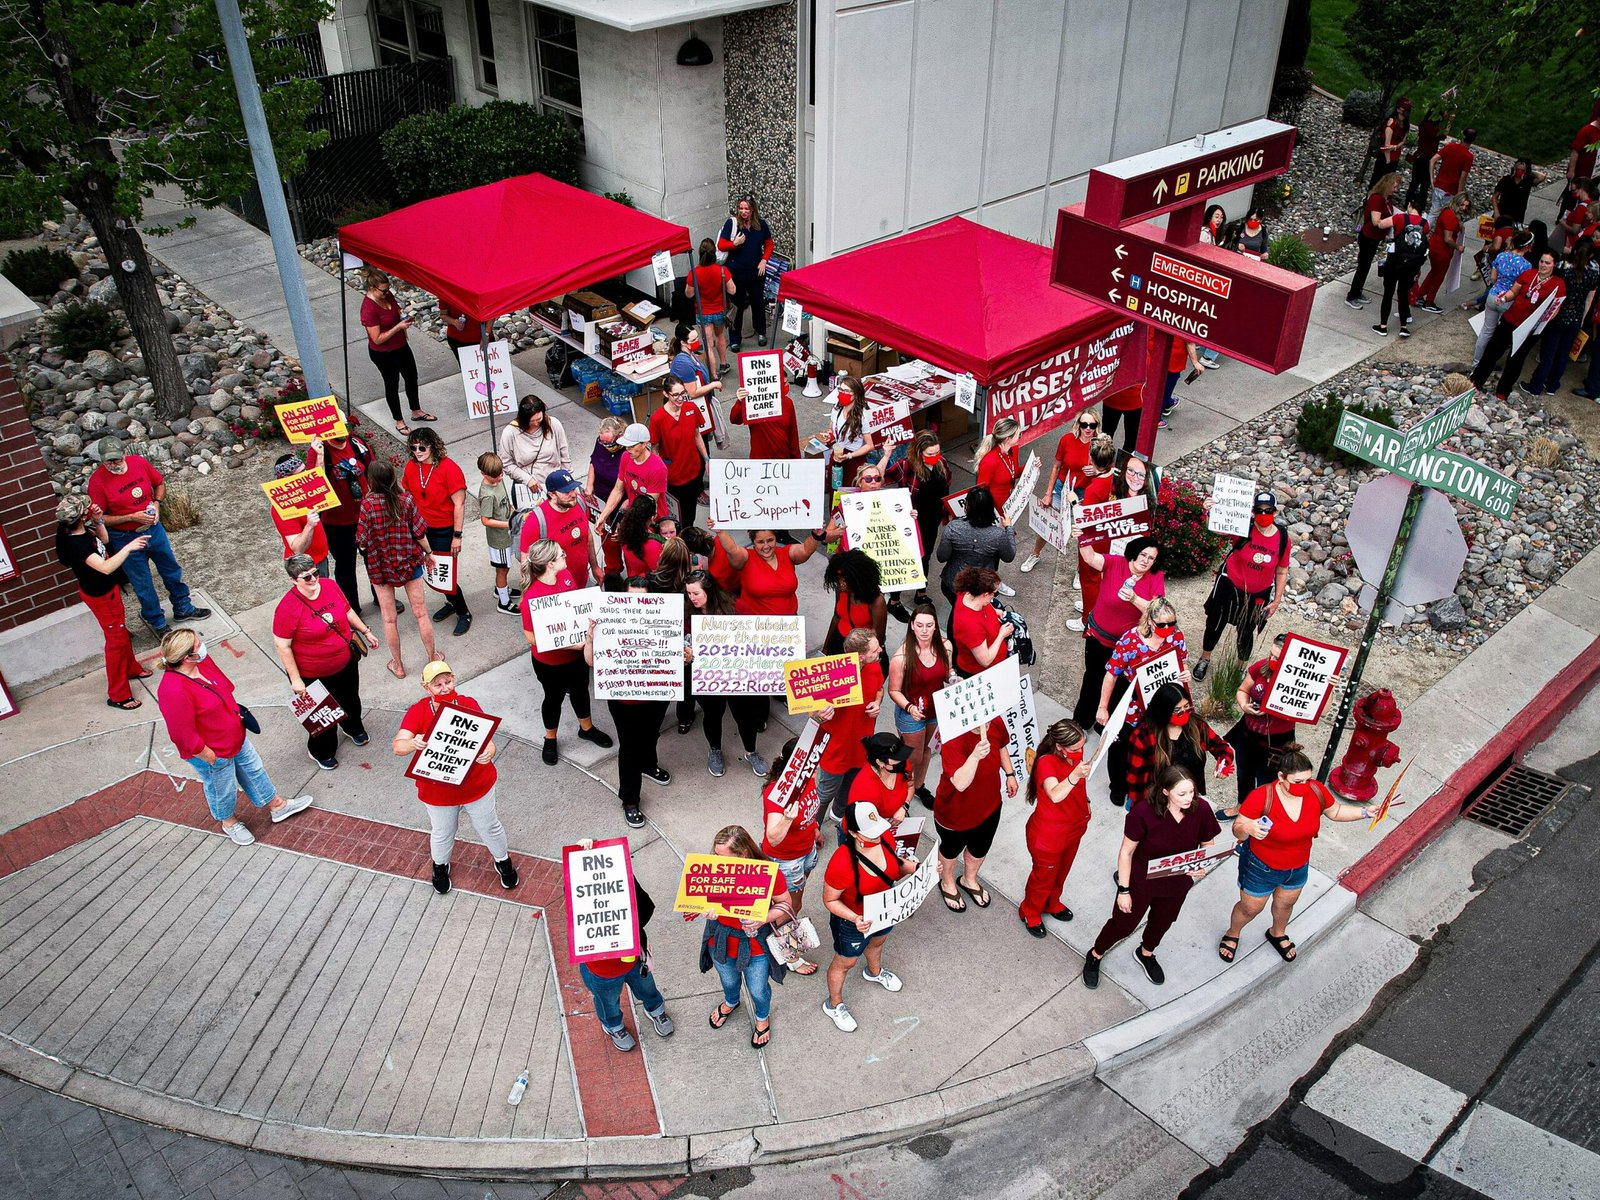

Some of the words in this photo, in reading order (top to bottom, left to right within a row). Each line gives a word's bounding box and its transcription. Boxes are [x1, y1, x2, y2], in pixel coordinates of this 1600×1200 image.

[1196, 149, 1265, 189] PARKING
[1154, 256, 1229, 293] EMERGENCY
[1147, 281, 1218, 320] HOSPITAL
[1143, 302, 1209, 338] PARKING
[617, 338, 639, 350] SAFE
[1097, 345, 1118, 360] Our
[474, 347, 499, 362] Hnk
[468, 369, 478, 379] If
[488, 366, 502, 374] You
[751, 359, 771, 370] RNs
[747, 375, 777, 386] STRIKE
[992, 363, 1079, 416] NURSES'
[1079, 358, 1120, 384] Patients
[747, 392, 779, 403] PATIENT
[753, 401, 774, 411] CARE
[282, 410, 294, 421] ON
[296, 400, 330, 417] STRIKE
[872, 406, 894, 420] SAFE
[286, 417, 299, 425] FOR
[300, 415, 314, 423] SAFE
[289, 421, 317, 433] PATIENT
[317, 414, 338, 425] CARE
[868, 416, 896, 428] STAFFING
[1423, 403, 1461, 449] SIXTH
[880, 424, 904, 437] SAVES
[889, 429, 915, 444] LIVES
[724, 461, 751, 480] Our
[760, 462, 790, 480] ICU
[1340, 438, 1359, 453] RENO
[1363, 434, 1373, 448] N
[1369, 433, 1490, 501] ARINGTON
[1491, 478, 1517, 500] AVE
[270, 487, 282, 498] ON
[284, 471, 318, 491] STRIKE
[725, 483, 741, 495] is
[756, 484, 778, 496] on
[276, 493, 290, 502] FOR
[290, 488, 304, 498] SAFE
[280, 496, 308, 509] PATIENT
[307, 485, 328, 497] CARE
[1215, 494, 1251, 509] SOMETHING
[715, 497, 751, 523] Life
[873, 501, 882, 509] IF
[1083, 503, 1122, 517] SAFE
[1485, 495, 1510, 516] 600
[1076, 511, 1123, 524] STAFFING
[1226, 511, 1249, 519] WRONG
[867, 525, 897, 534] NURSES
[1096, 518, 1135, 531] SAVES
[1108, 523, 1149, 537] LIVES
[861, 541, 900, 550] OUTSIDE
[875, 533, 892, 541] ARE
[875, 548, 900, 557] THEN
[438, 563, 449, 583] RNs
[882, 568, 907, 576] RONG
[530, 595, 562, 612] SMRMC
[564, 600, 571, 608] IS
[606, 595, 633, 605] SAINT
[546, 622, 567, 635] THAN
[573, 620, 580, 630] A
[702, 617, 753, 632] Nurses
[754, 616, 800, 632] labeled
[553, 636, 565, 648] BP
[569, 630, 588, 645] CUFF
[695, 634, 729, 645] over
[734, 631, 760, 644] the
[760, 634, 802, 648] years
[1298, 647, 1327, 664] RNs
[790, 667, 809, 679] ON
[811, 656, 852, 674] STRIKE
[1146, 660, 1169, 676] RNs
[1284, 664, 1328, 683] STRIKE
[1303, 662, 1316, 670] on
[793, 678, 810, 688] FOR
[810, 674, 830, 685] SAFE
[1144, 671, 1178, 693] STRIKE
[1154, 671, 1164, 679] on
[795, 682, 831, 696] PATIENT
[832, 675, 856, 687] CARE
[944, 675, 983, 700] SOME
[1276, 683, 1321, 702] PATIENT
[1294, 679, 1310, 689] for
[954, 682, 992, 706] CUTS
[1280, 695, 1310, 710] CARE
[295, 701, 317, 718] STAFFING
[309, 705, 332, 723] SAVES
[949, 692, 995, 719] NEVER
[319, 707, 345, 728] LIVES
[450, 715, 480, 732] RNs
[961, 704, 998, 727] HEAL
[1006, 711, 1018, 730] far
[434, 732, 479, 750] STRIKE
[454, 729, 467, 737] on
[1022, 717, 1035, 748] Your
[454, 745, 469, 754] for
[1009, 732, 1020, 758] cry
[424, 749, 470, 766] PATIENT
[428, 761, 458, 774] CARE
[777, 747, 804, 791] SAFE
[1013, 758, 1024, 782] from
[777, 751, 808, 804] STAFFING
[582, 854, 614, 871] RNs
[1160, 849, 1206, 867] SAFE
[592, 872, 606, 880] on
[690, 863, 713, 875] ON
[716, 864, 770, 875] STRIKE
[575, 880, 625, 898] STRIKE
[690, 876, 710, 884] FOR
[712, 876, 736, 885] SAFE
[883, 858, 933, 909] HONK
[689, 885, 735, 894] PATIENT
[736, 886, 766, 896] CARE
[593, 898, 609, 909] for
[900, 892, 919, 914] YOU
[577, 908, 628, 926] PATIENT
[586, 924, 620, 939] CARE
